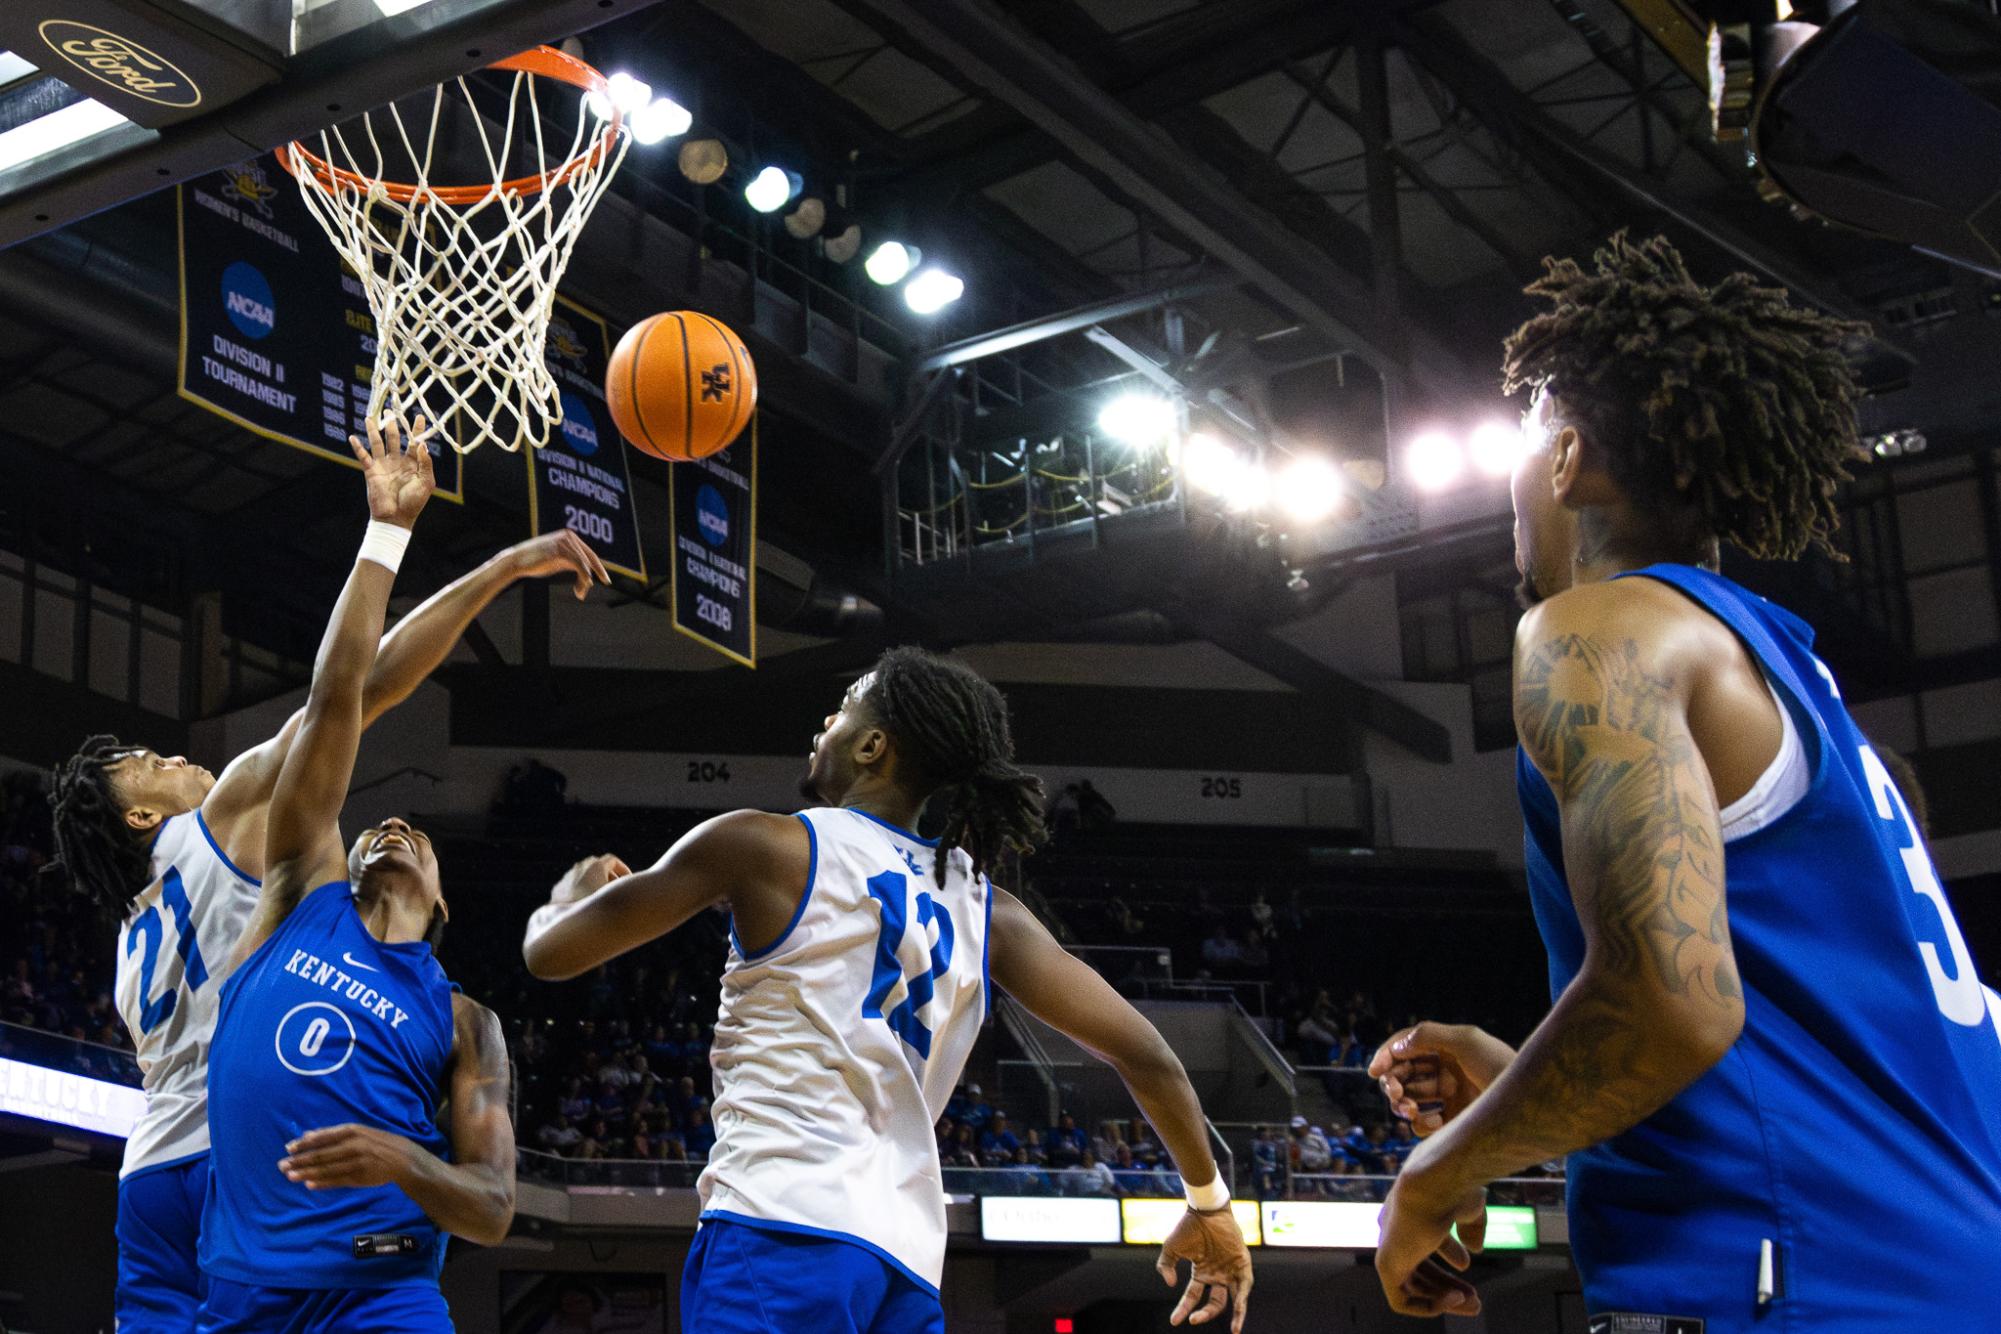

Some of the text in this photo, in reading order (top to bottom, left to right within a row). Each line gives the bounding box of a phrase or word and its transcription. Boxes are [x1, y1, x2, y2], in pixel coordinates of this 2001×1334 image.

[62, 38, 176, 93] Ford
[227, 290, 275, 329] NCAA
[213, 334, 285, 383] DIVISION II
[201, 354, 297, 414] TOURNAMENT
[562, 418, 599, 447] NCAA
[537, 448, 577, 470] DIVISION
[548, 467, 620, 510] CHAMPIONS
[564, 504, 614, 544] 2000
[696, 593, 732, 632] 2008
[688, 762, 730, 782] 204
[1202, 778, 1240, 798] 205
[127, 865, 209, 1035] 21
[861, 869, 955, 1060] 12
[285, 949, 409, 1029] KENTUCKY
[299, 1017, 330, 1057] 0
